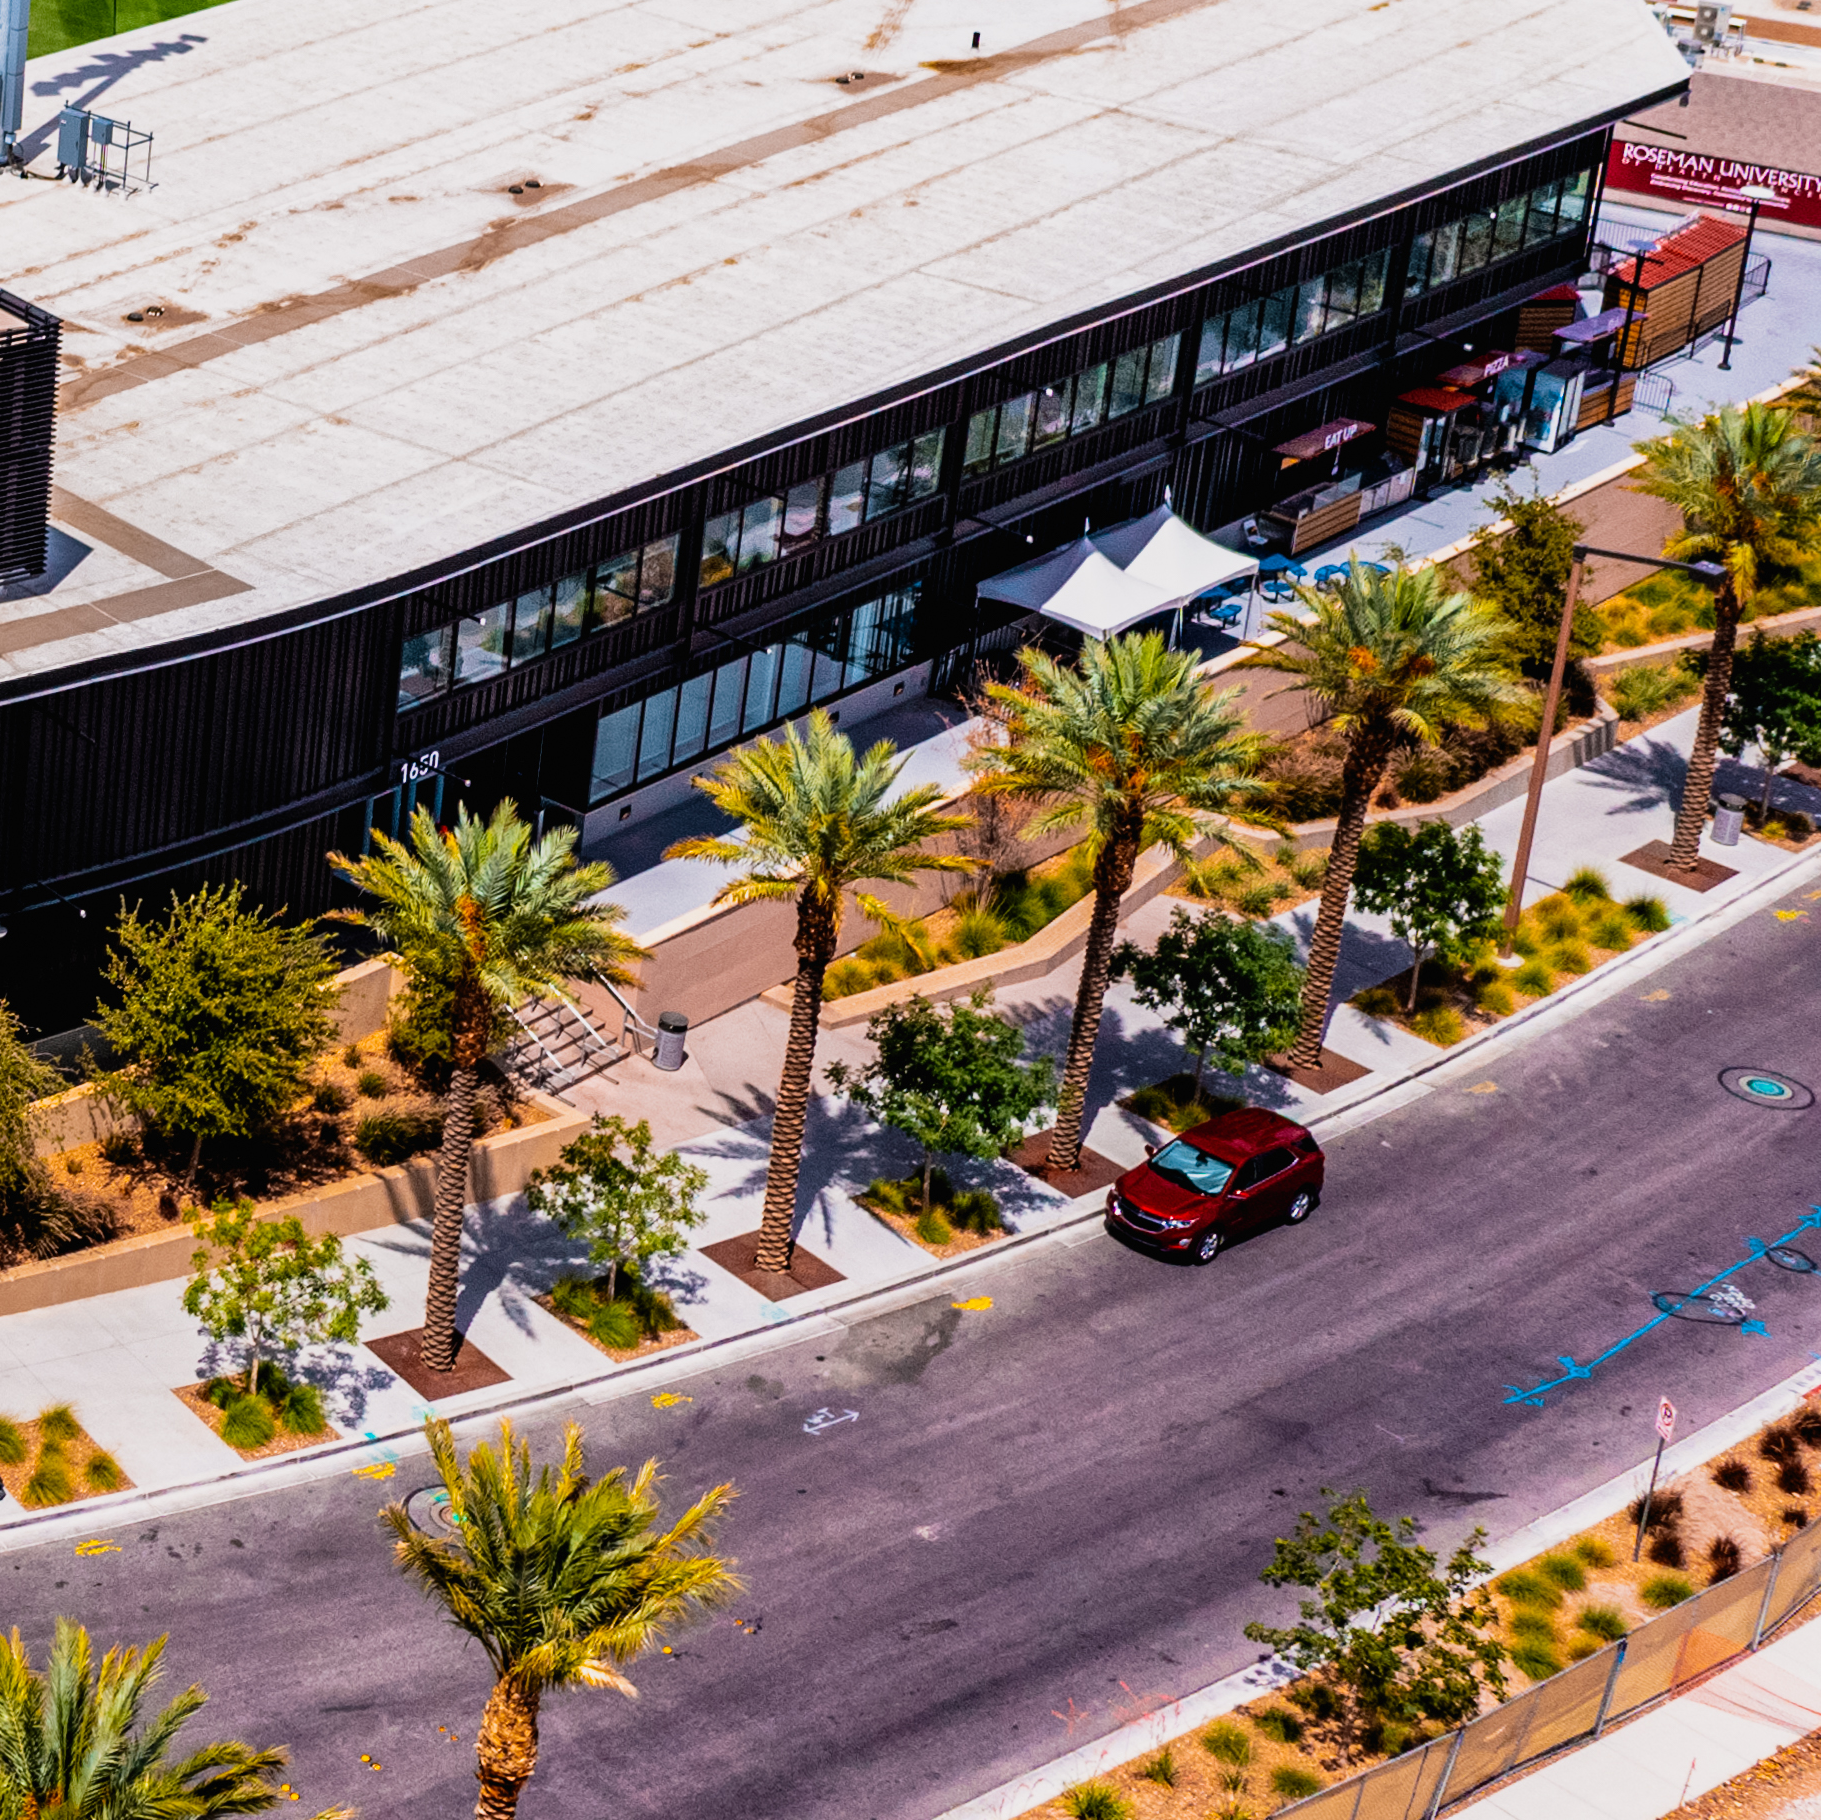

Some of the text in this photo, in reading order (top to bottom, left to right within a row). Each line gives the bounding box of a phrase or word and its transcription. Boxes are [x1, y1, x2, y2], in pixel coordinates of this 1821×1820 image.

[1623, 143, 1714, 173] ROSEMAN
[1325, 423, 1358, 450] EAT UP
